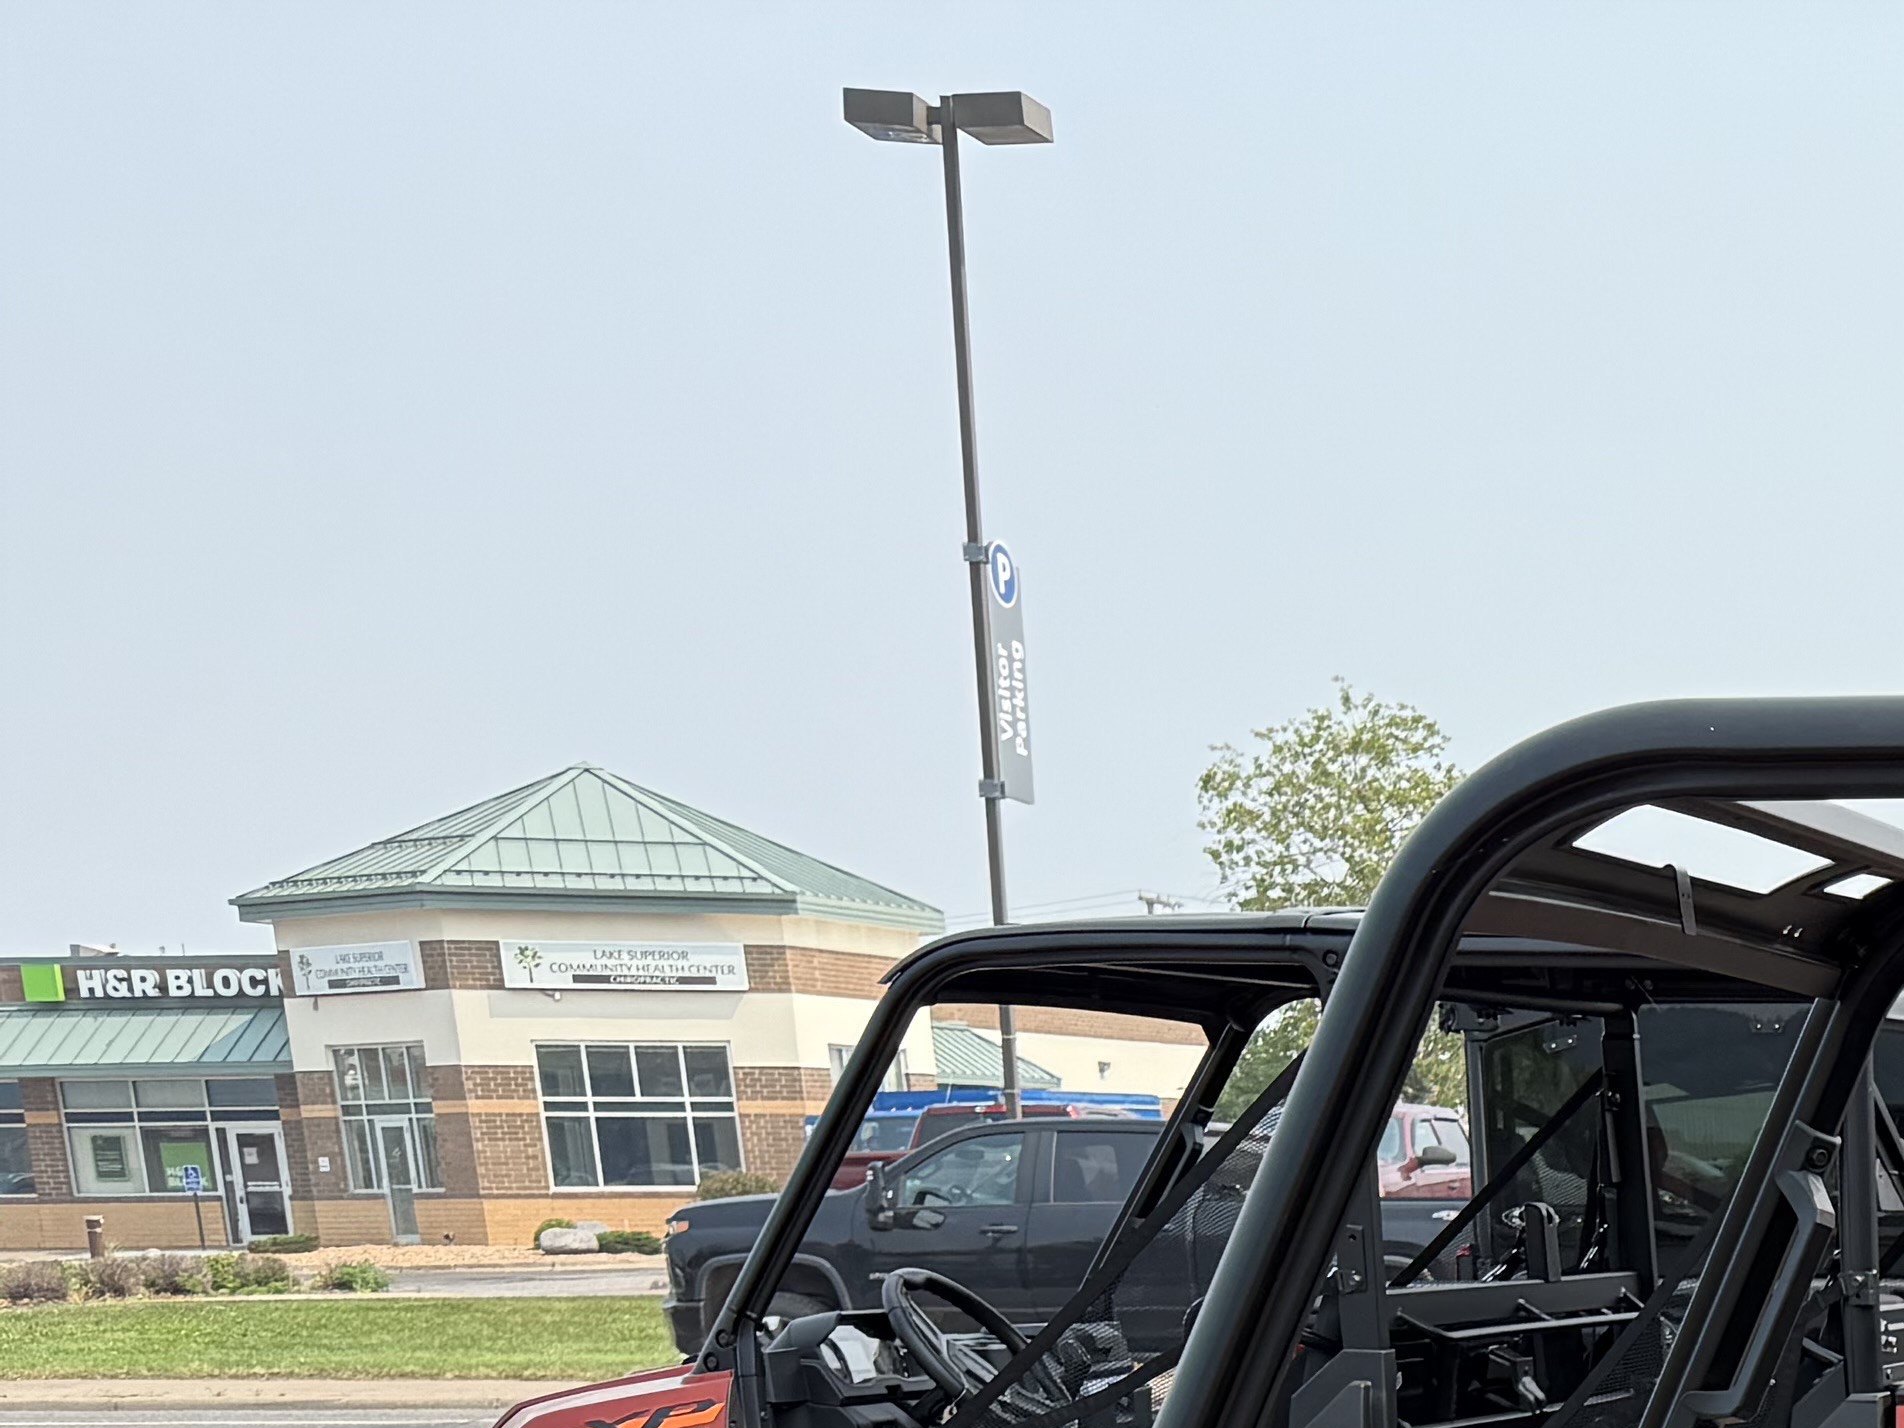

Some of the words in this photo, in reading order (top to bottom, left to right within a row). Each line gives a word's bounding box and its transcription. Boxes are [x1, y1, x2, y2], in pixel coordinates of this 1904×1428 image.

[997, 642, 1014, 741] Visitor
[1011, 640, 1029, 756] Parking
[549, 962, 632, 974] COMMUNITY
[636, 963, 685, 975] HEALTH
[688, 964, 736, 976] CENTER
[593, 949, 624, 961] LAKE
[627, 950, 689, 961] SUPERIOR
[76, 969, 162, 999] H&R
